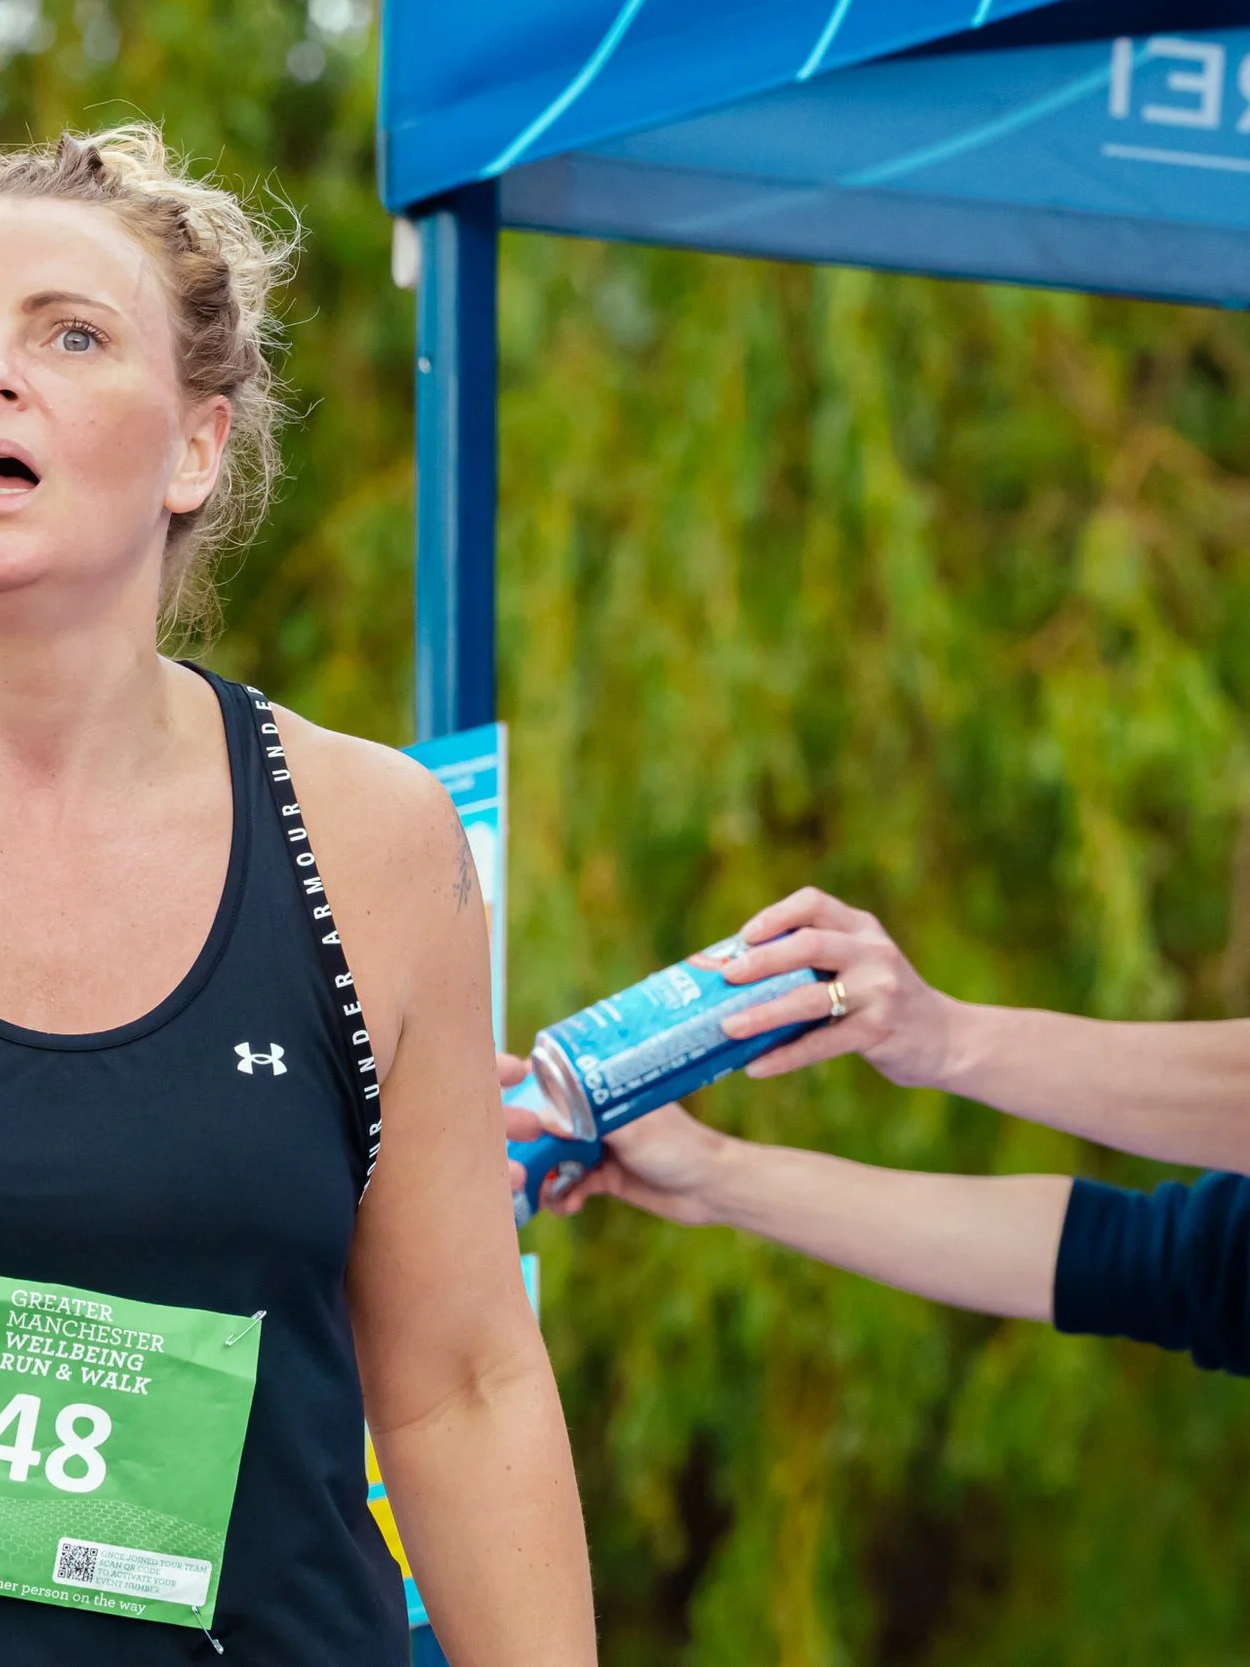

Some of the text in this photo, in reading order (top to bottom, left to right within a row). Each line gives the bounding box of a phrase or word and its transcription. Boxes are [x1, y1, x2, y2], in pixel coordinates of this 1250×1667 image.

[282, 802, 341, 946] ARMOUR
[334, 970, 380, 1100] UNDER
[11, 1289, 114, 1322] GREATER
[6, 1310, 165, 1353] MANCHESTER
[5, 1331, 145, 1372] WELLBEING
[55, 1363, 72, 1381] &
[80, 1366, 152, 1395] WALK
[99, 1560, 162, 1576] SCAN QR CODE
[110, 1570, 151, 1583] ACTIVATE
[152, 1576, 177, 1588] YOUR
[160, 1560, 183, 1569] YOUR
[184, 1563, 208, 1573] TEAM
[21, 1583, 69, 1602] person
[72, 1592, 90, 1604] on
[94, 1593, 116, 1608] the
[119, 1600, 147, 1616] way
[96, 1577, 160, 1594] EVENT NUMBER
